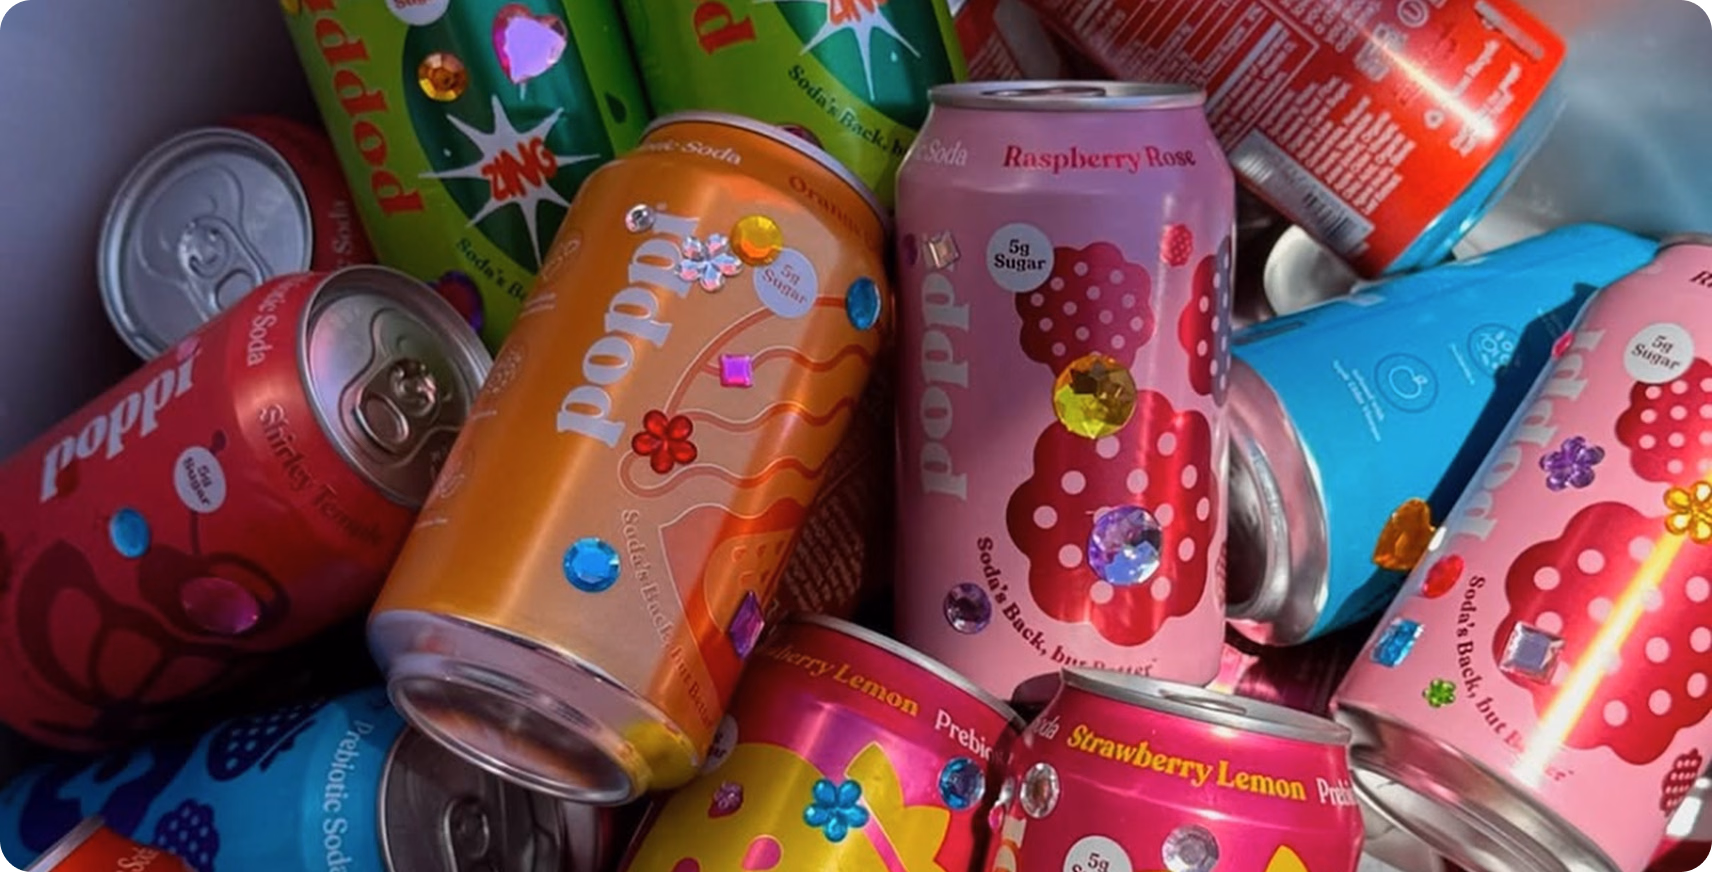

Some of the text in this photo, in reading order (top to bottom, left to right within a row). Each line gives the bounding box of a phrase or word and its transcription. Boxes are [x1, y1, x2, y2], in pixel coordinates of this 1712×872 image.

[788, 64, 837, 117] Soda's
[481, 137, 558, 200] ZING
[681, 139, 742, 166] Soda
[930, 139, 968, 167] Soda
[1003, 145, 1197, 174] Raspberry Rose
[456, 237, 506, 288] Soda's
[993, 254, 1047, 273] Sugar
[1008, 238, 1030, 257] 5g
[762, 268, 808, 305] Sugar
[246, 314, 278, 368] Soda
[1631, 343, 1681, 371] Sugar
[1651, 334, 1674, 355] 5g
[258, 402, 314, 492] Shirley
[181, 456, 211, 506] Sugar
[620, 508, 650, 580] Soda's
[976, 536, 1008, 603] Soda's
[1002, 601, 1048, 656] Back,
[1455, 574, 1487, 638] Soda's
[833, 663, 920, 718] Lemon
[1456, 640, 1484, 700] Back,
[1475, 697, 1508, 735] but
[323, 719, 375, 813] Prebiotic
[1067, 723, 1214, 788] Strawberry
[1216, 759, 1308, 801] Lemon
